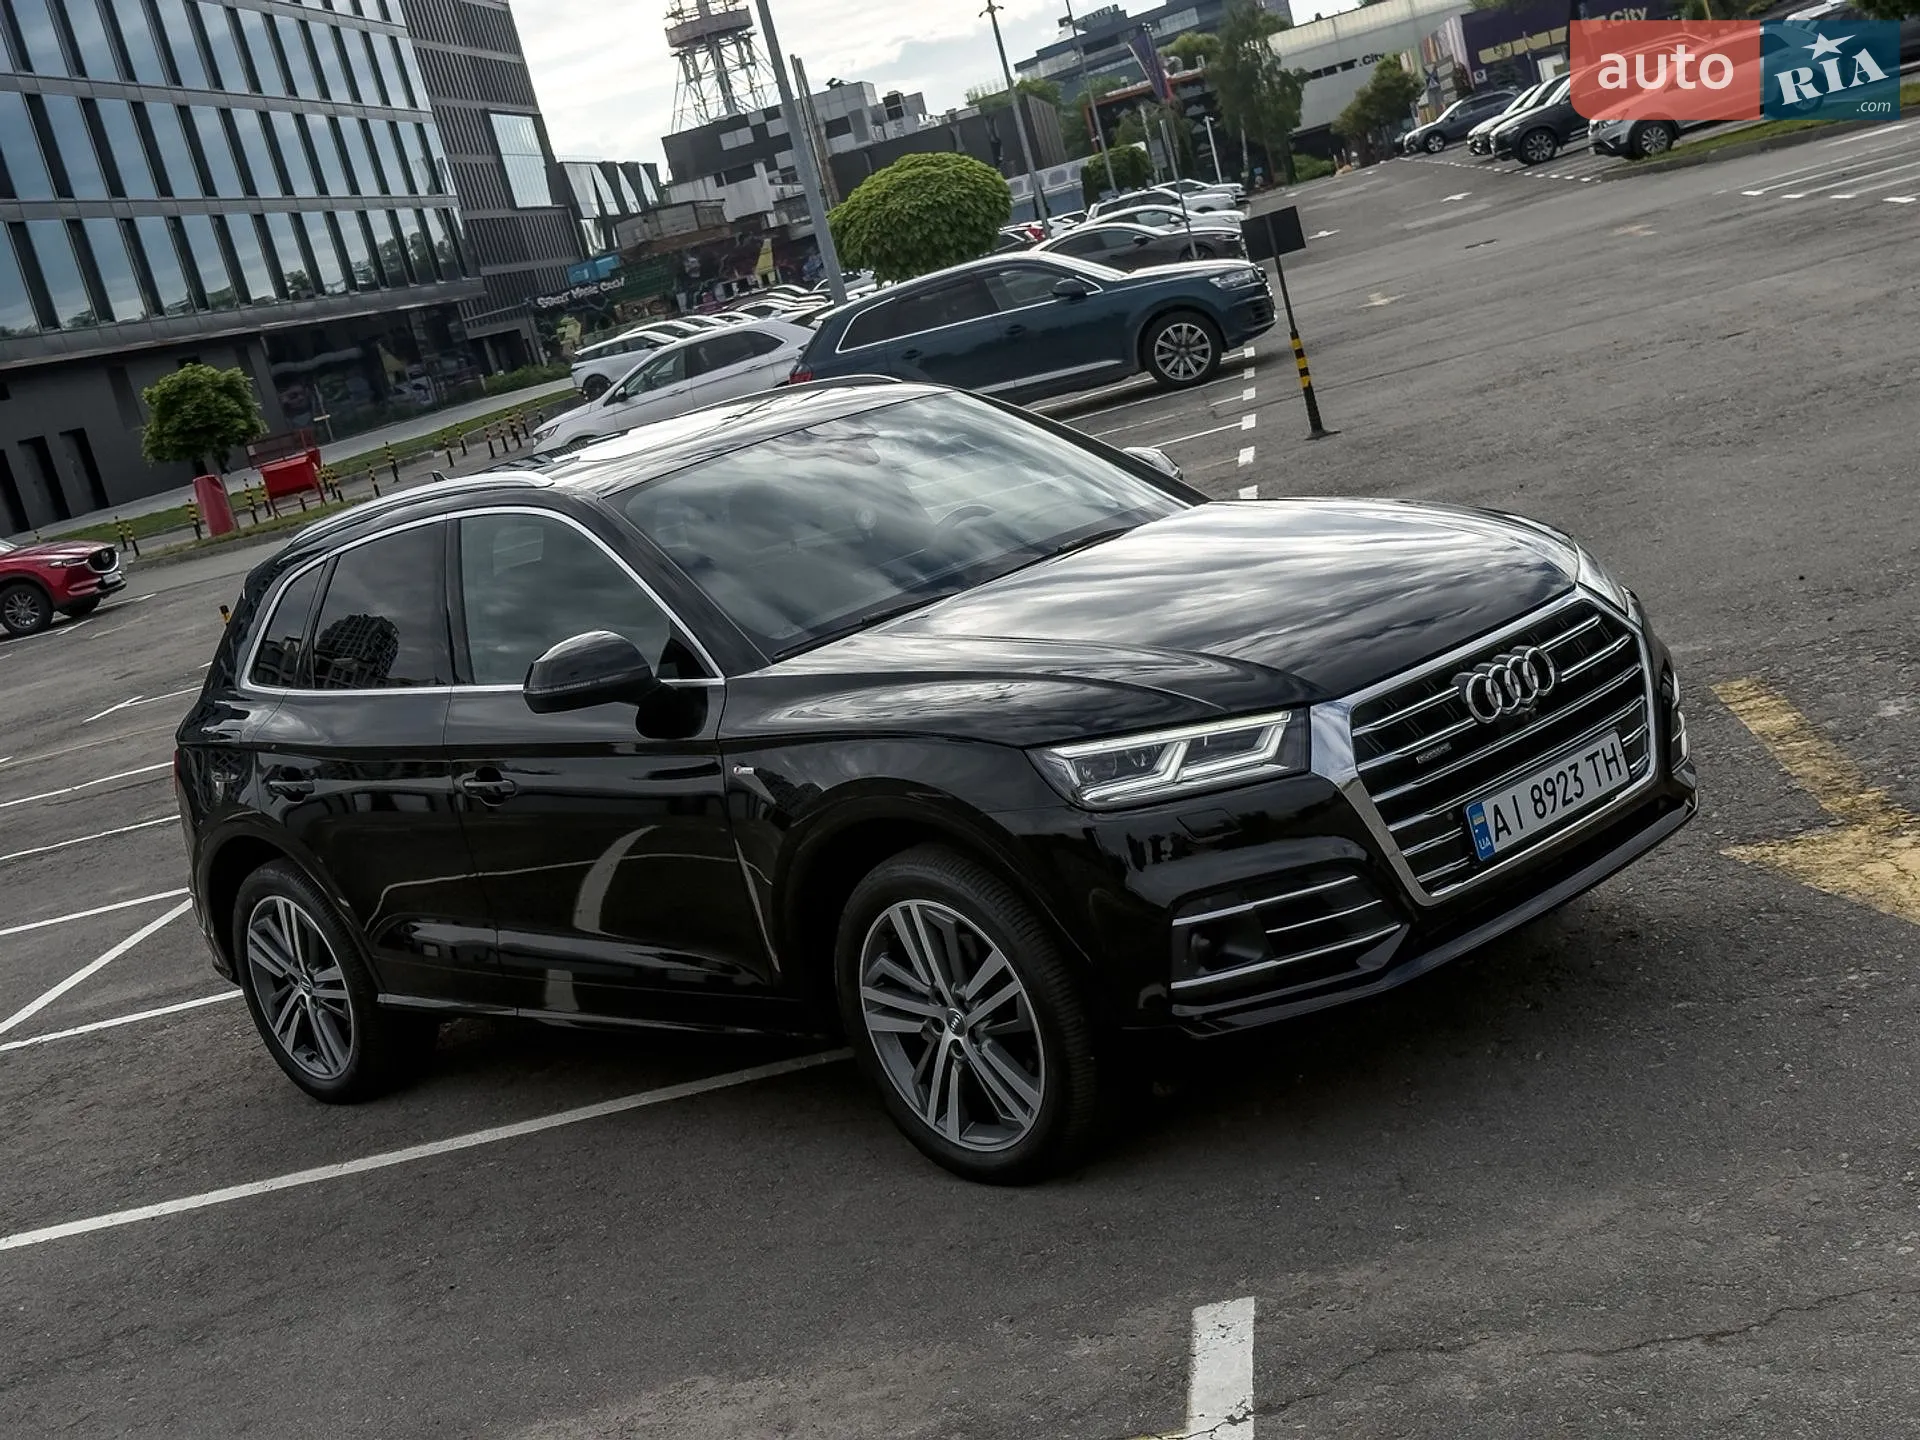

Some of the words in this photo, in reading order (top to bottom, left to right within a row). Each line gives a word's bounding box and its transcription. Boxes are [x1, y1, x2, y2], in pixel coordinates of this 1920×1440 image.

[1493, 794, 1524, 843] AI
[1530, 762, 1585, 820] 8923
[1585, 742, 1622, 788] TH
[1477, 836, 1492, 850] UA
